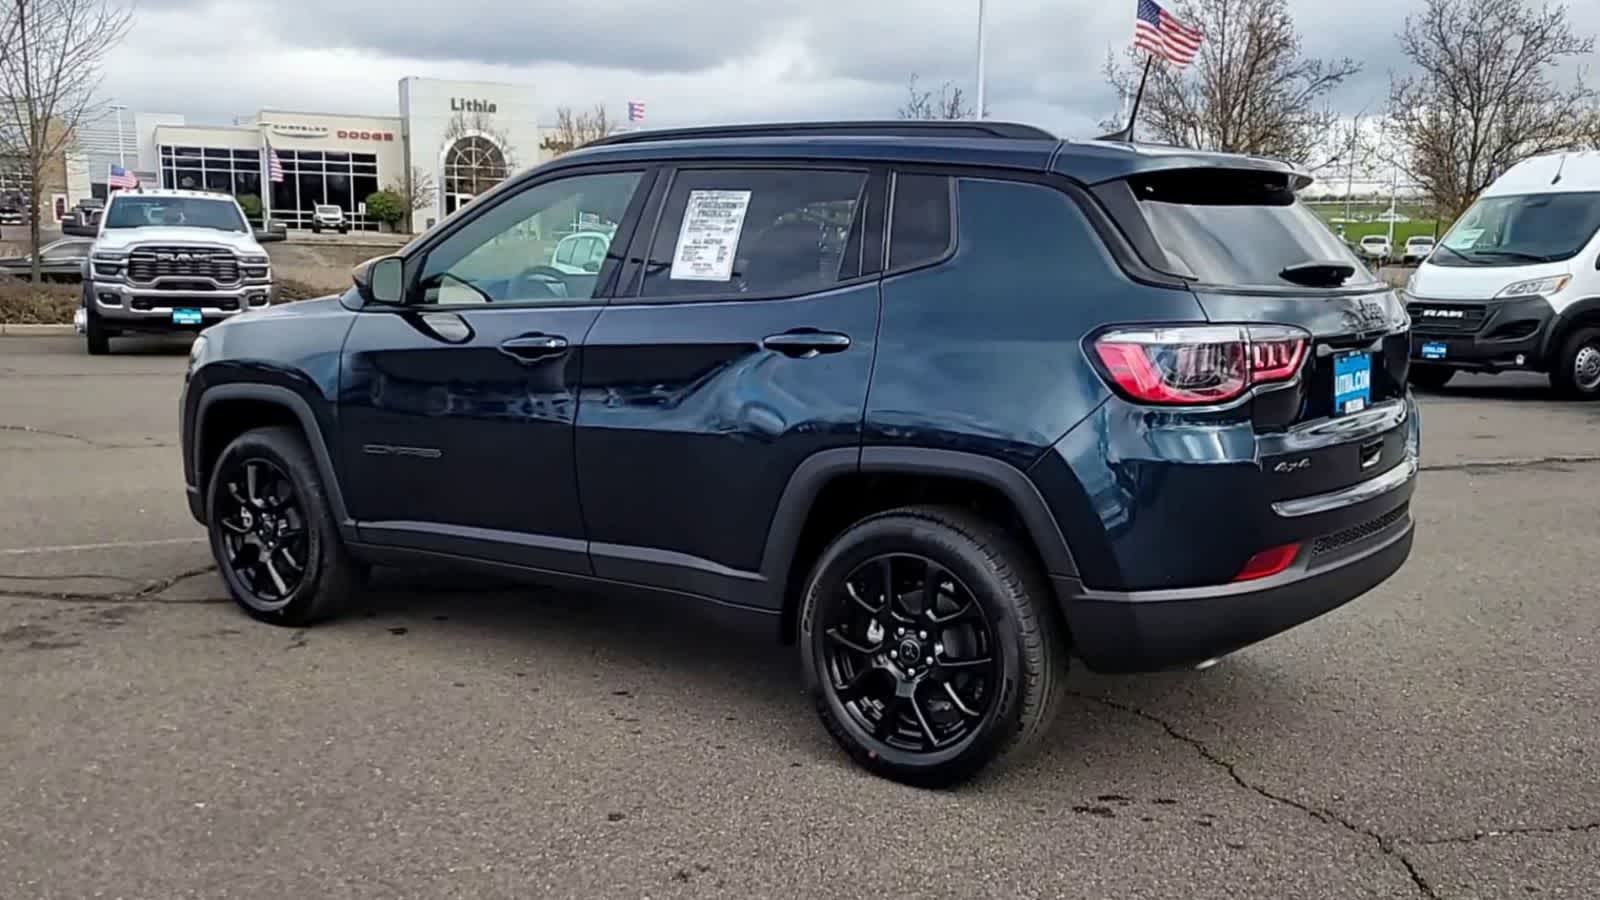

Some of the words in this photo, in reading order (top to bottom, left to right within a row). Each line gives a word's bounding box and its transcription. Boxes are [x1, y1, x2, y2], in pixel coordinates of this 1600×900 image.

[450, 97, 497, 113] Lithia
[337, 131, 394, 141] DODGE
[1423, 309, 1465, 318] RAM
